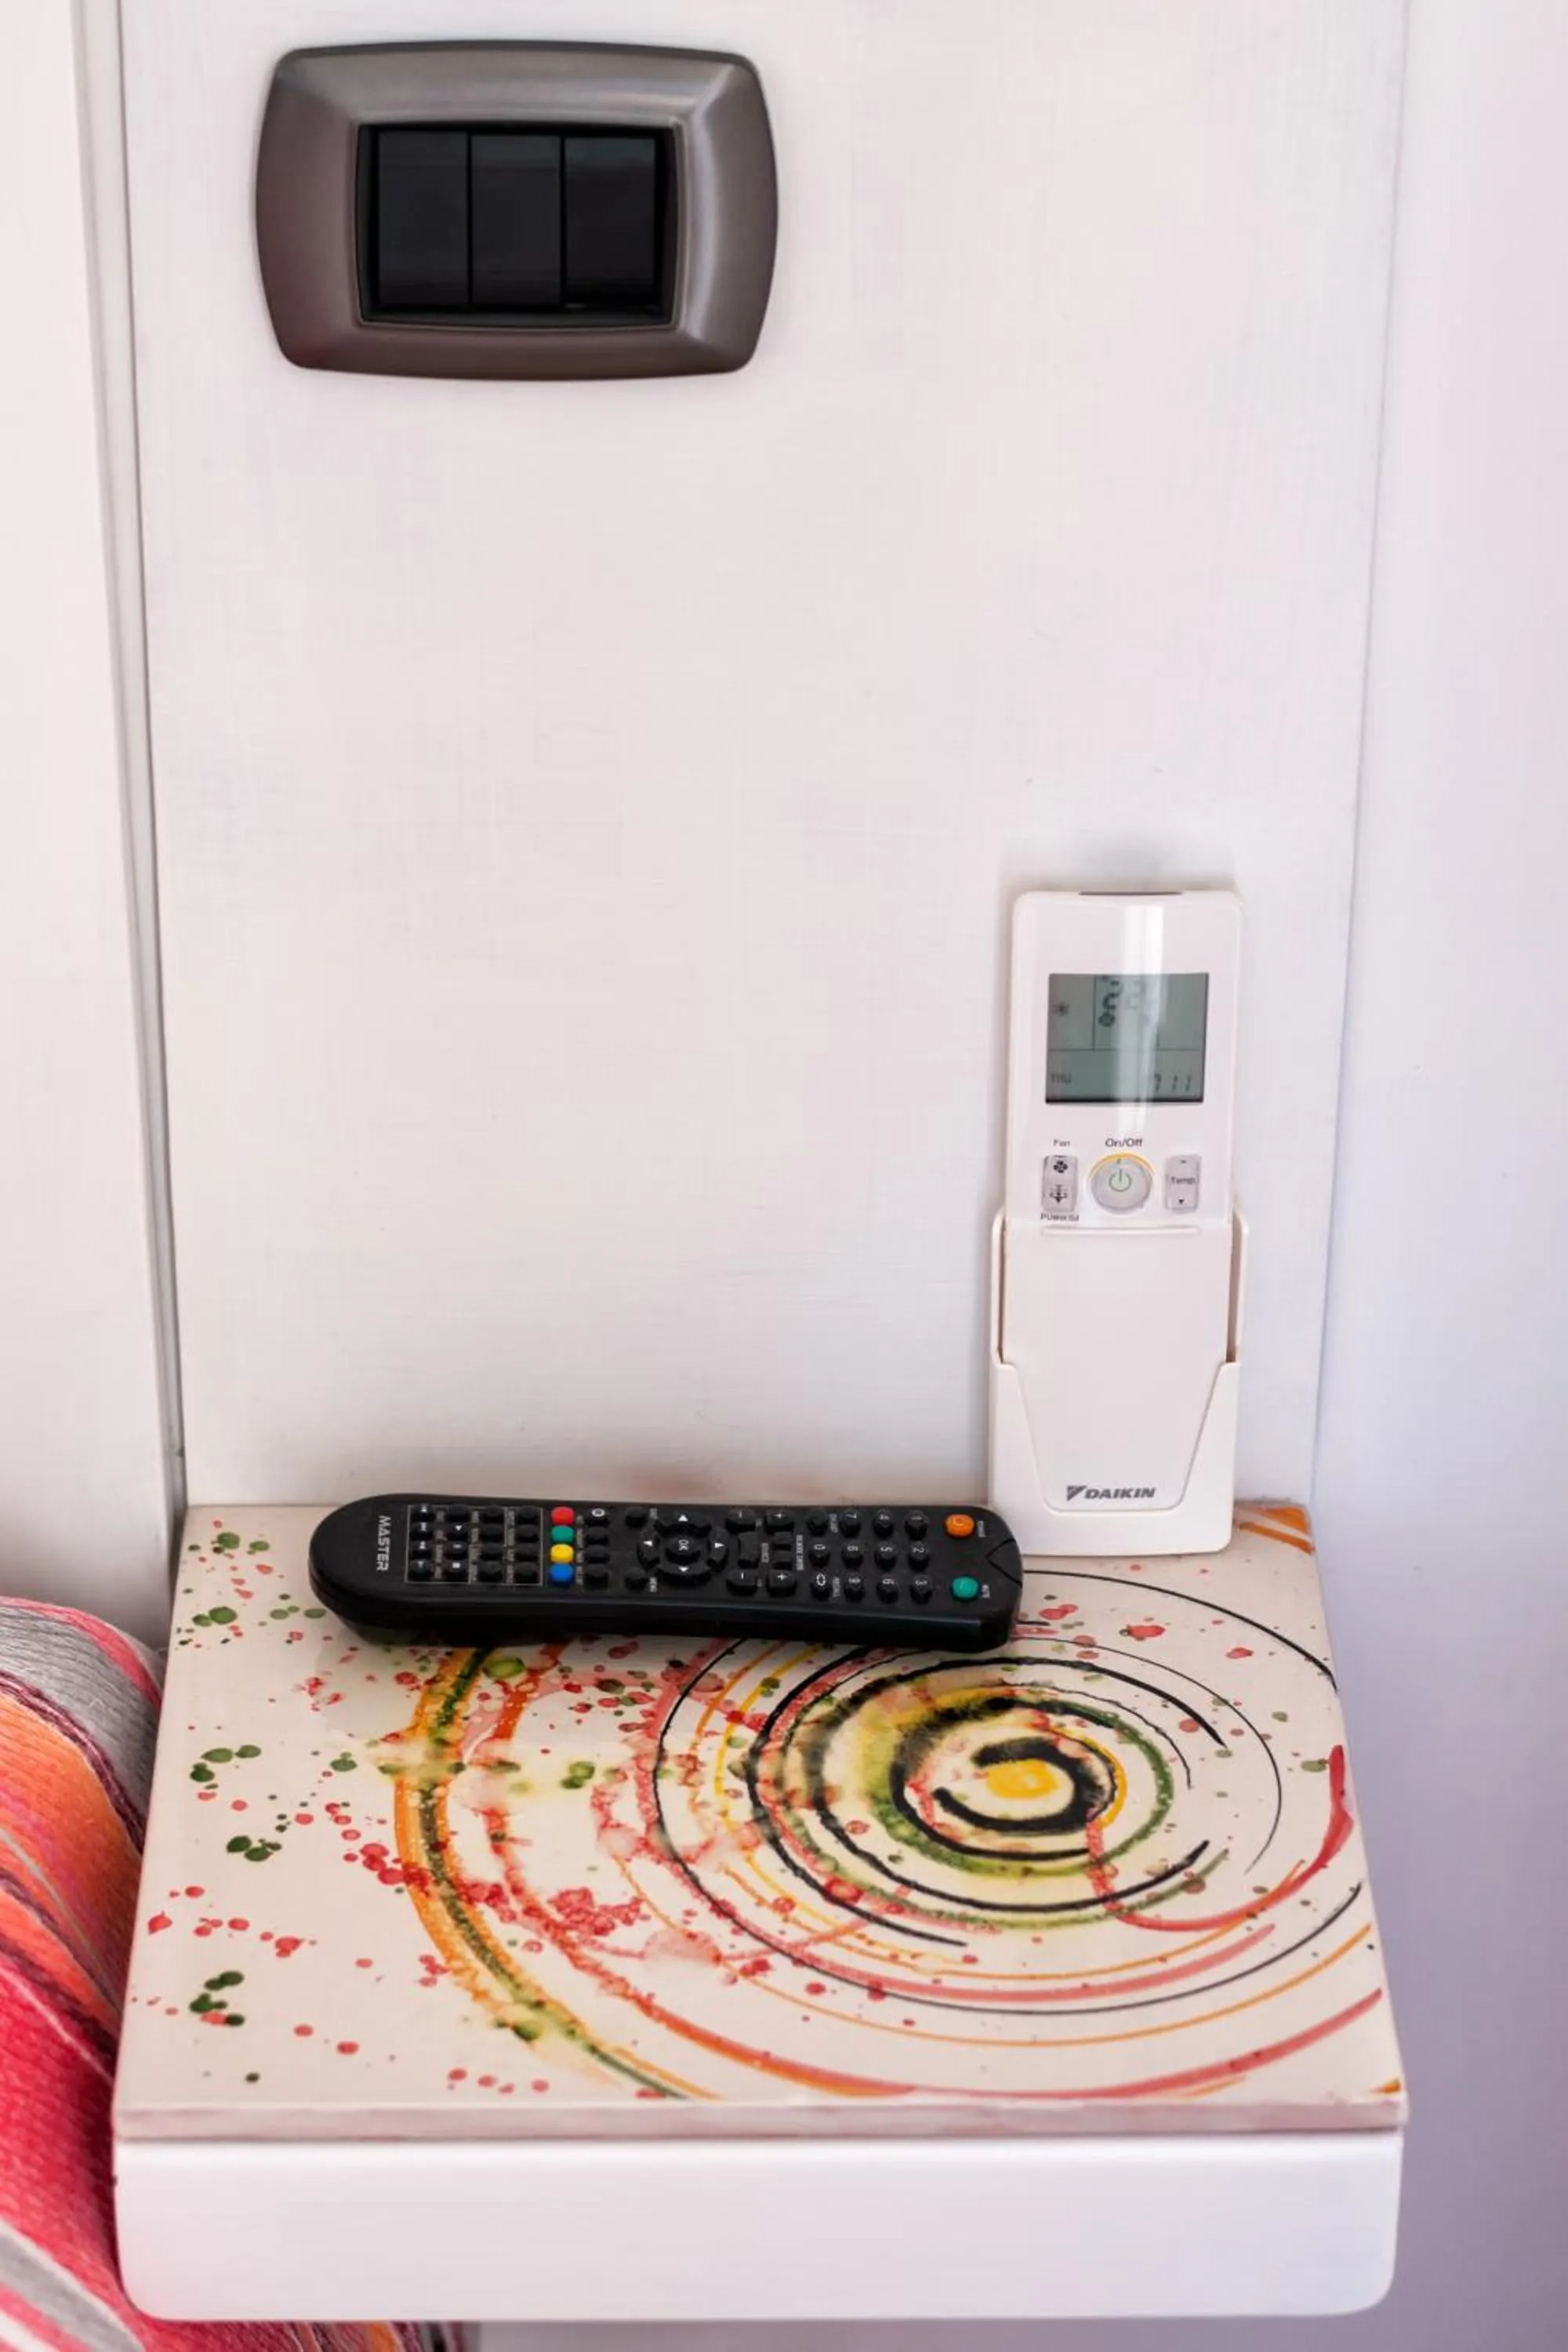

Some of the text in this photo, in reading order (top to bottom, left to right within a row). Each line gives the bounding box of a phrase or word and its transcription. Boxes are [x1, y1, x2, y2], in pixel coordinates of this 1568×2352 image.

[1104, 1138, 1143, 1148] On/Off
[1171, 1177, 1196, 1185] Temp
[1084, 1486, 1156, 1500] DAIKIN
[376, 1515, 392, 1572] MASTER
[677, 1538, 689, 1551] OK
